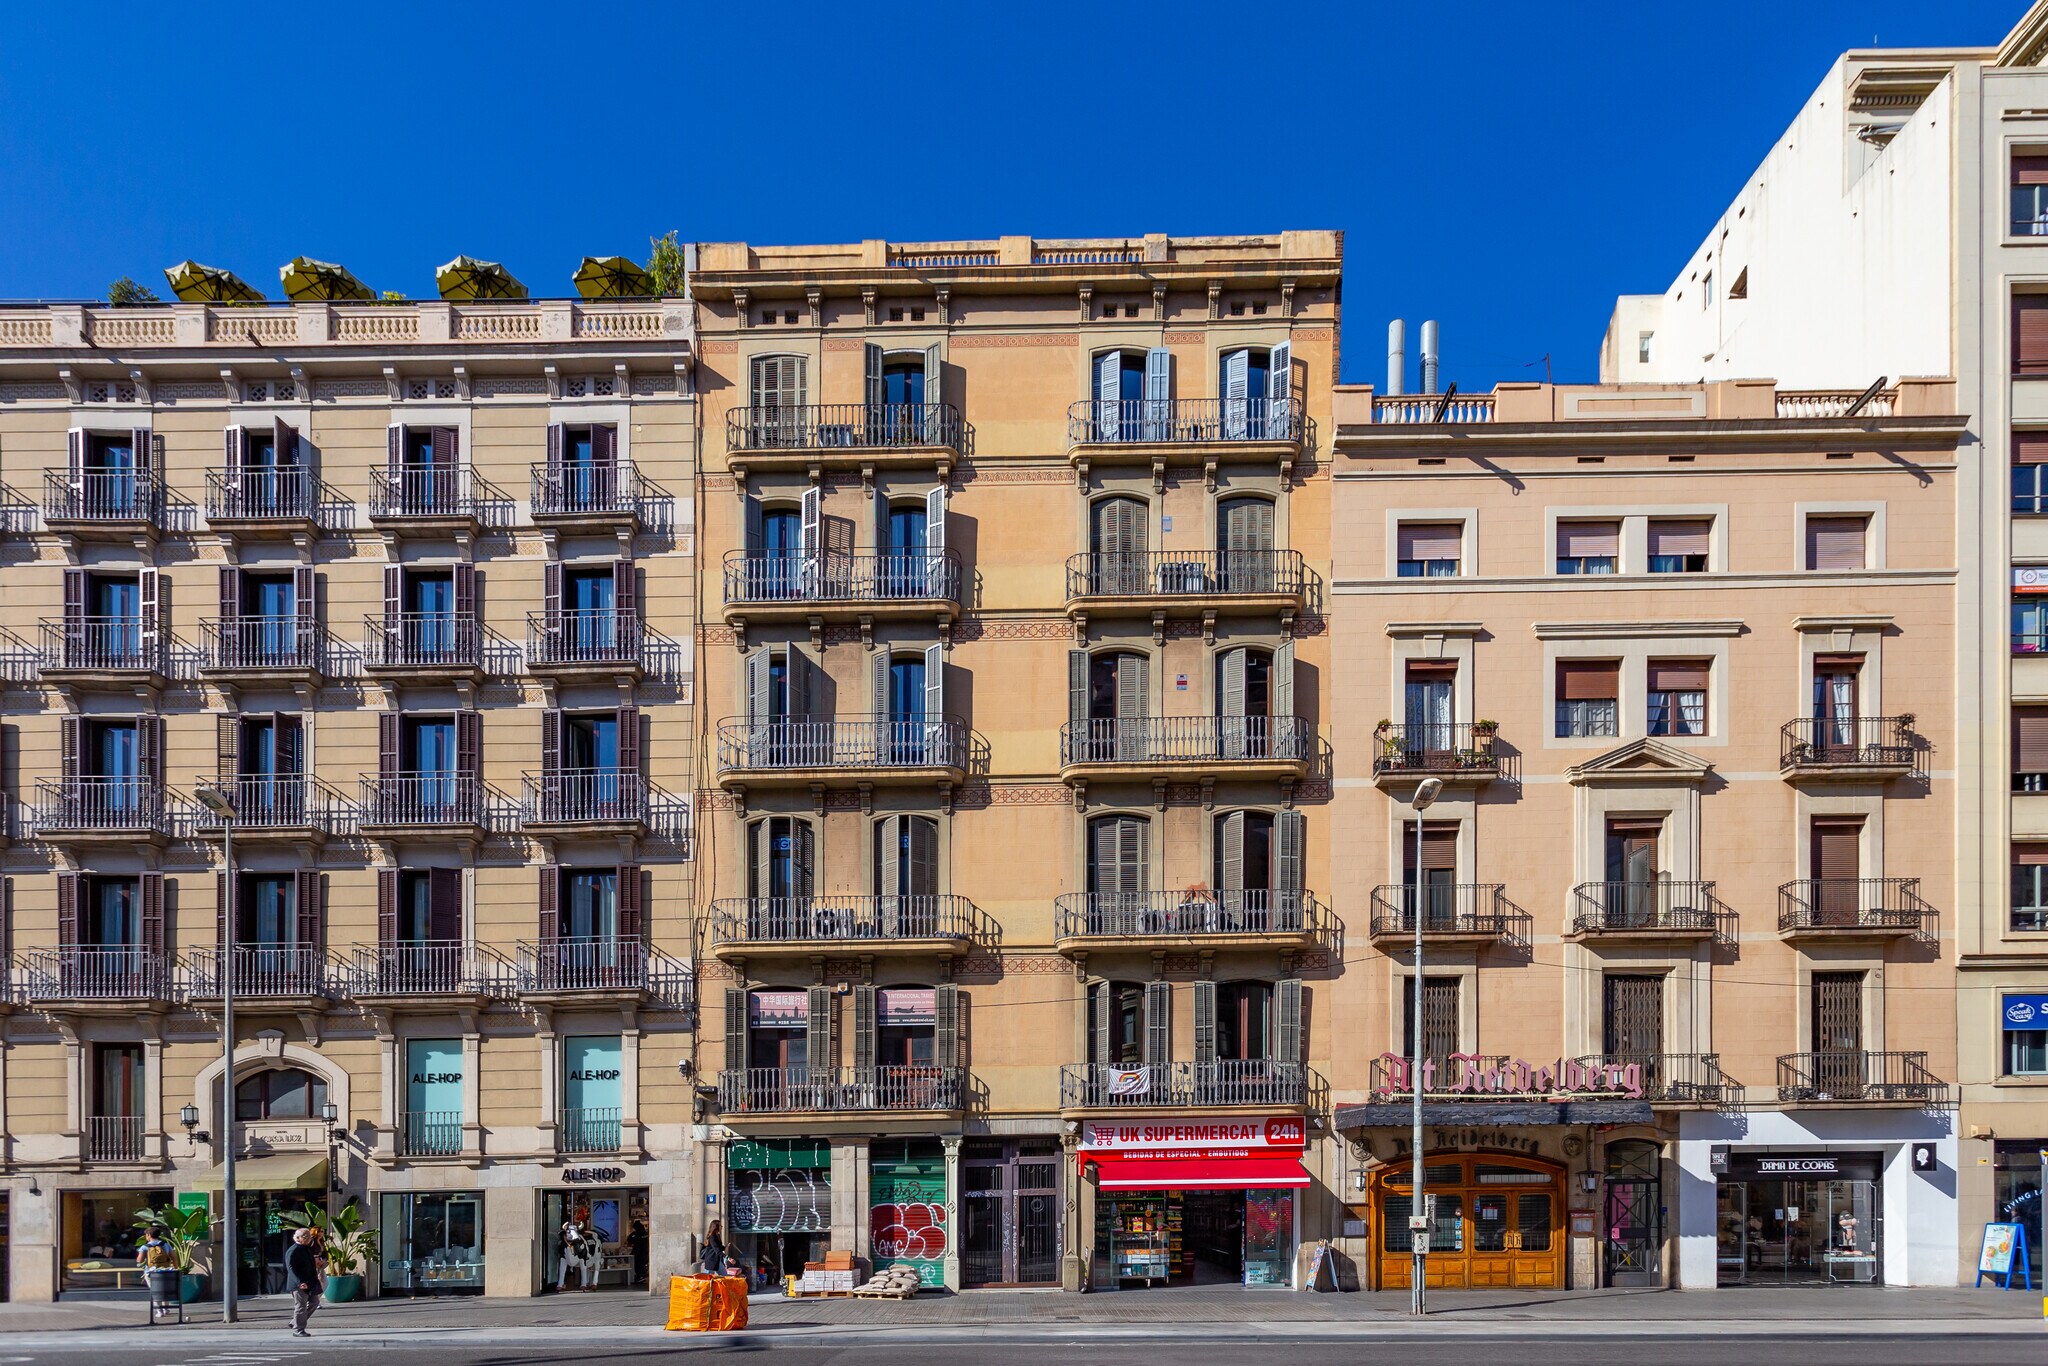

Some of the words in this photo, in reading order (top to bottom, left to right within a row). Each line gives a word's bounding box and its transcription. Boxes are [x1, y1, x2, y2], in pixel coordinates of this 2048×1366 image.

[412, 1073, 462, 1084] ALE-HOP
[570, 1070, 620, 1081] ALE-HOP
[1449, 1052, 1644, 1099] Heidelberg
[1119, 1126, 1141, 1142] UK
[1144, 1124, 1258, 1142] SUPERMERCAT
[1270, 1123, 1299, 1140] 24h
[1166, 1150, 1200, 1158] ESPECIAL
[1762, 1162, 1786, 1170] DAMA
[1789, 1161, 1800, 1170] DE
[1802, 1161, 1835, 1170] COPAS
[561, 1167, 621, 1181] ALE-HOP
[2003, 1191, 2032, 1213] LIVING
